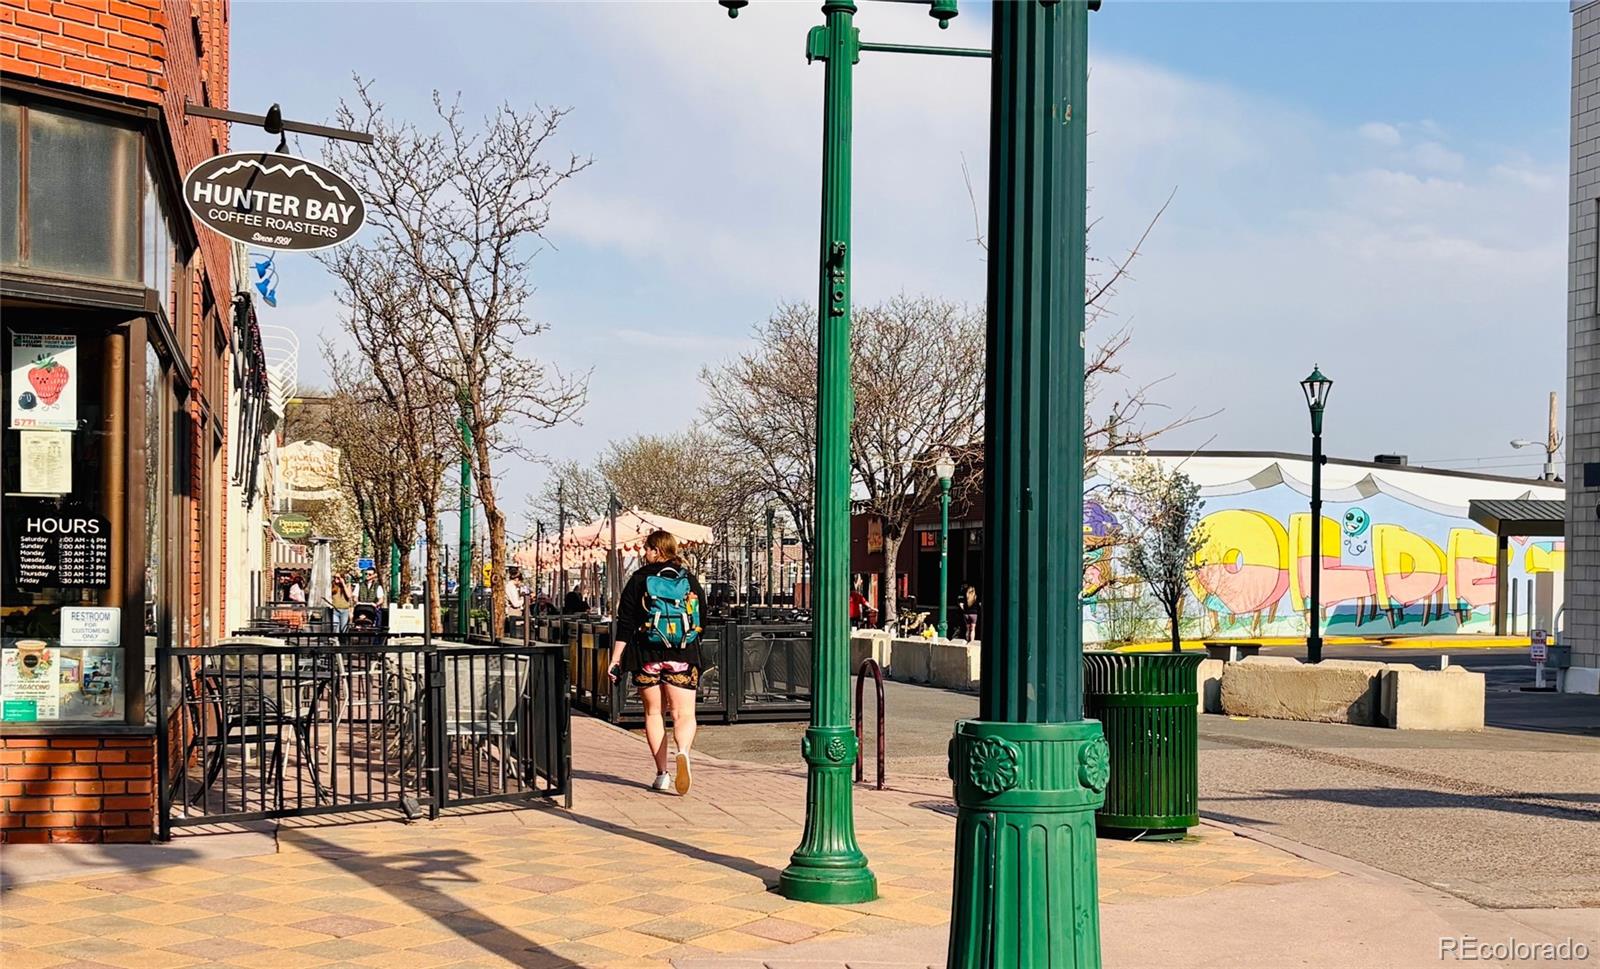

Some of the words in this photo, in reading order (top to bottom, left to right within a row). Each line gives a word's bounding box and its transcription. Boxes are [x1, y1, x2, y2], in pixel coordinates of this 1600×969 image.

[192, 181, 300, 218] HUNTER
[305, 198, 357, 226] BAY
[207, 208, 263, 228] COFFEE
[265, 216, 338, 239] ROASTERS
[251, 232, 273, 244] Since
[274, 234, 292, 246] 1991
[27, 517, 100, 534] HOURS
[20, 535, 49, 544] Saturday
[20, 542, 44, 550] Sunday
[20, 556, 47, 564] Tuesday
[20, 563, 57, 571] Wednesday
[20, 570, 49, 578] Thursday
[19, 577, 40, 585] Friday
[71, 611, 111, 621] RESTROOM
